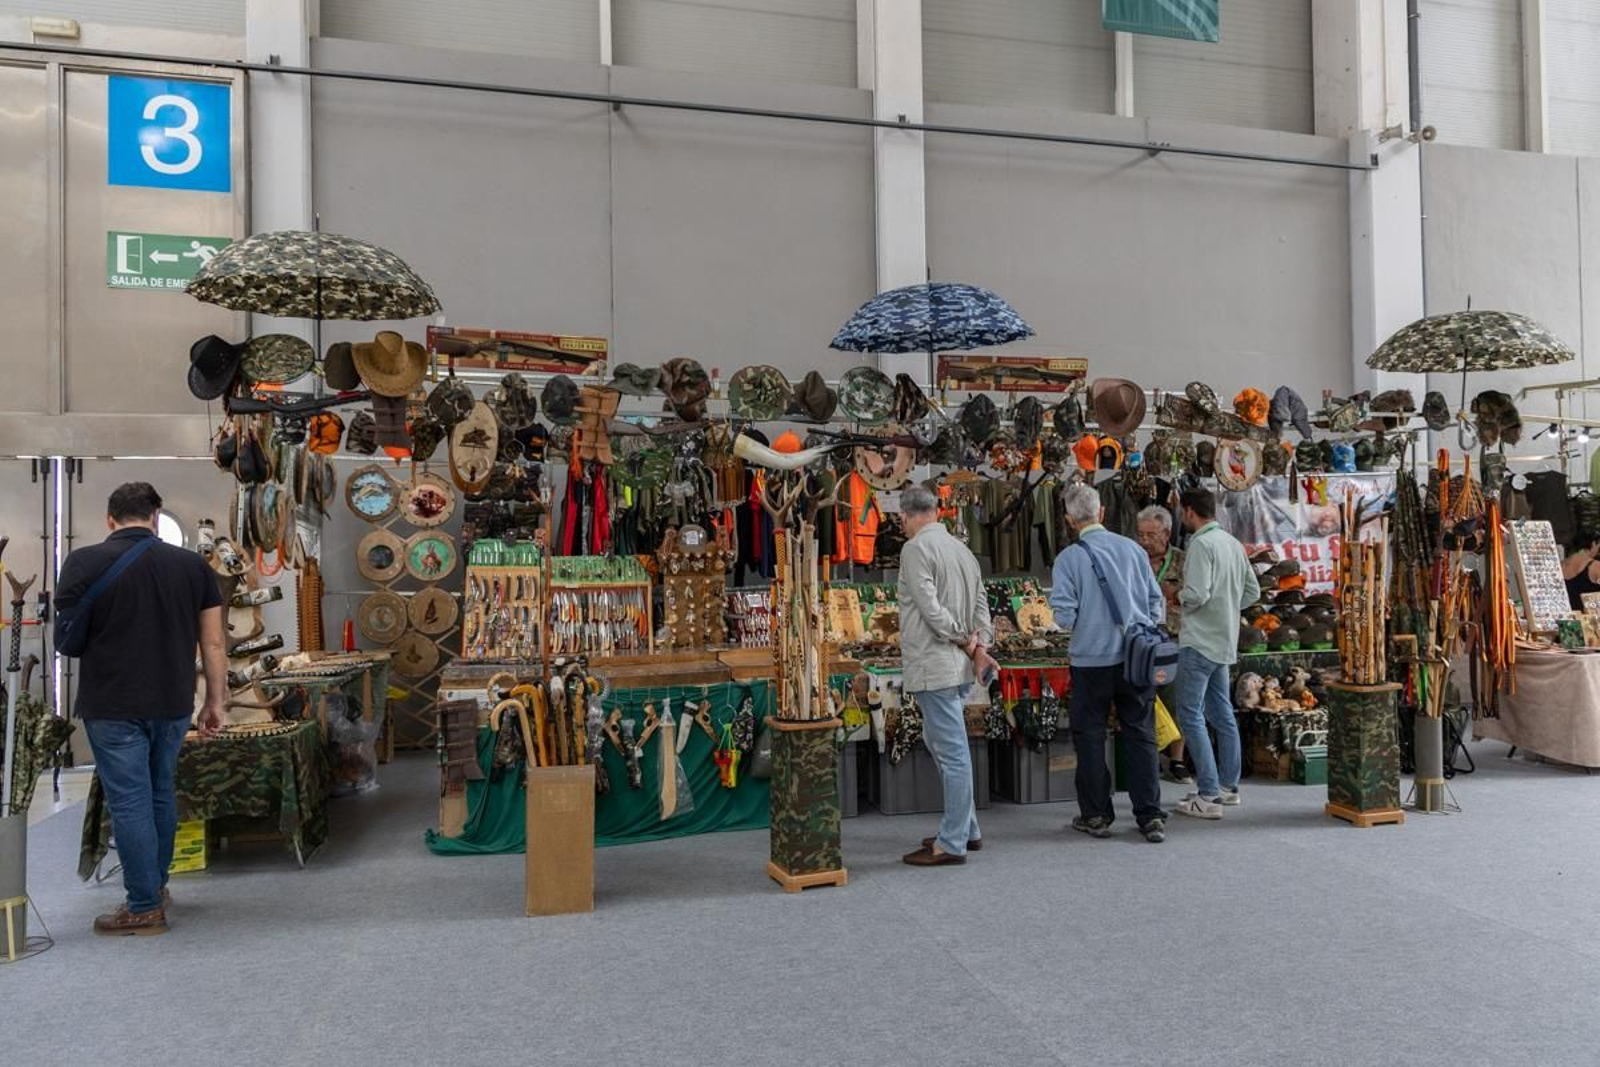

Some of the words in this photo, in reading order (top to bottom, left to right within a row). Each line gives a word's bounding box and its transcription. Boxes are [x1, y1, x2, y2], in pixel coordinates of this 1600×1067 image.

[140, 94, 203, 176] 3
[111, 275, 149, 287] SALIDA
[149, 278, 164, 287] DE
[1282, 539, 1321, 562] tu
